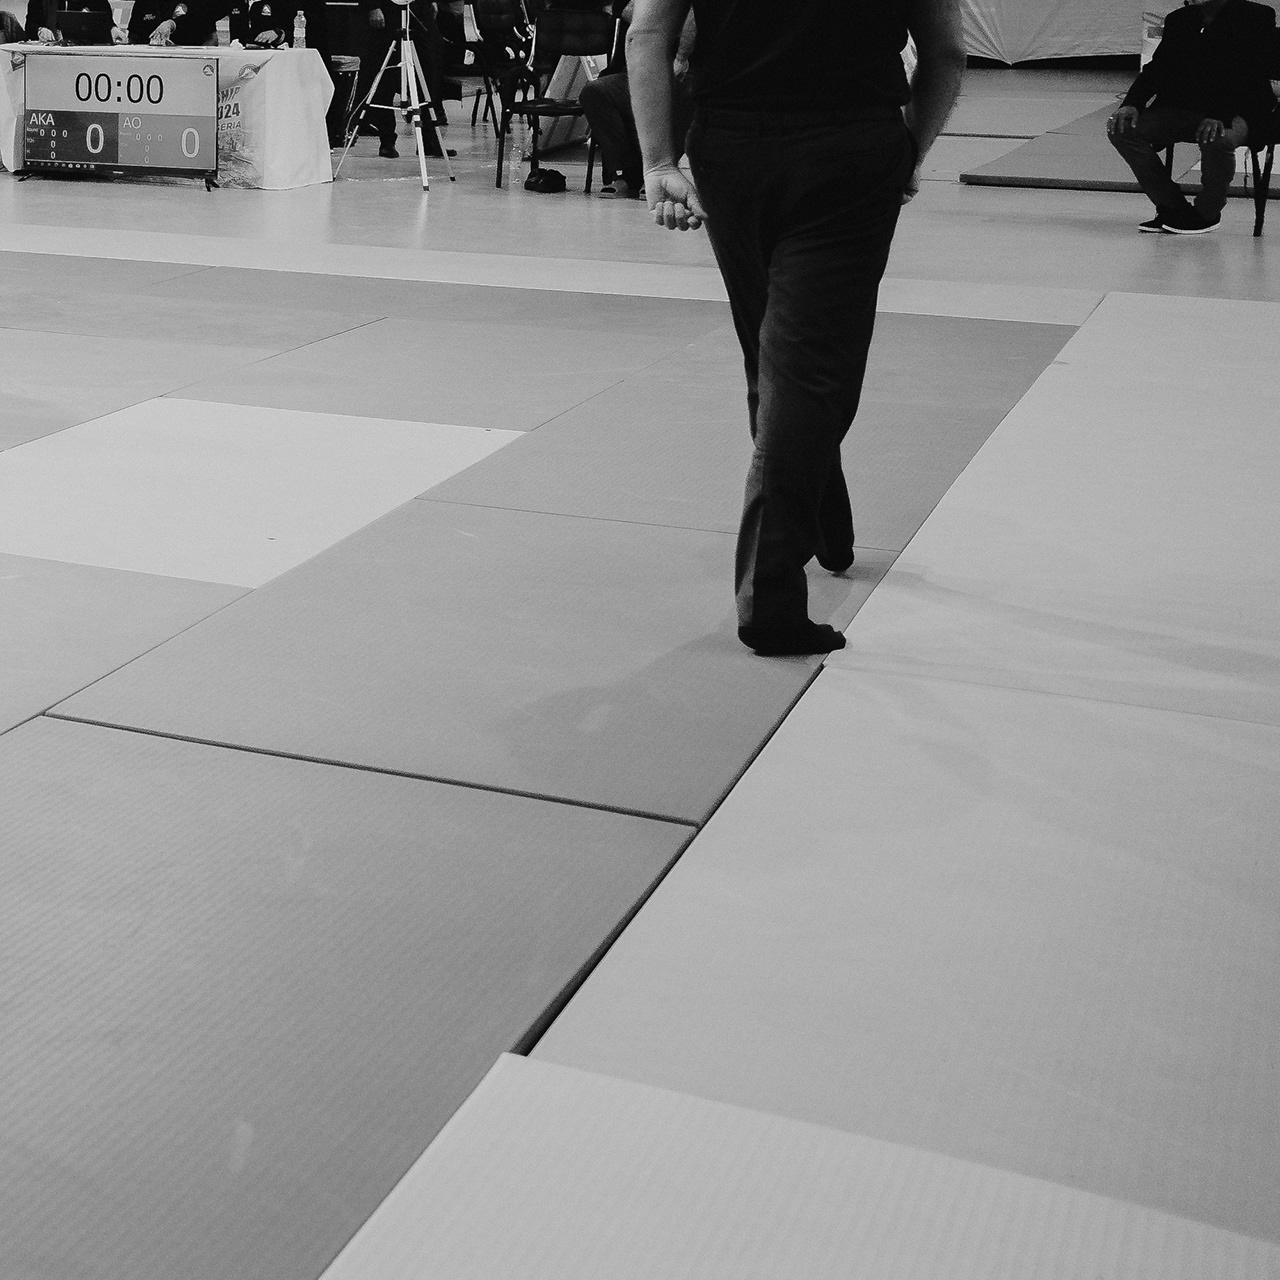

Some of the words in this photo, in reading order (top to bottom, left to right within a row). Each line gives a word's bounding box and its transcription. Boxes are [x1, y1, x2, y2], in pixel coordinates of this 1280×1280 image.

[75, 72, 164, 104] 00:00
[29, 113, 55, 126] AKA
[123, 116, 142, 129] AO
[39, 128, 45, 137] 0
[51, 129, 57, 137] 0
[62, 129, 68, 138] 0
[135, 133, 141, 141] 0
[146, 133, 152, 141] 0
[157, 133, 163, 141] 0
[86, 123, 104, 154] 0
[181, 127, 200, 158] 0
[50, 140, 56, 148] 0
[144, 144, 150, 152] 0
[50, 151, 56, 159] 0
[144, 155, 150, 164] 0
